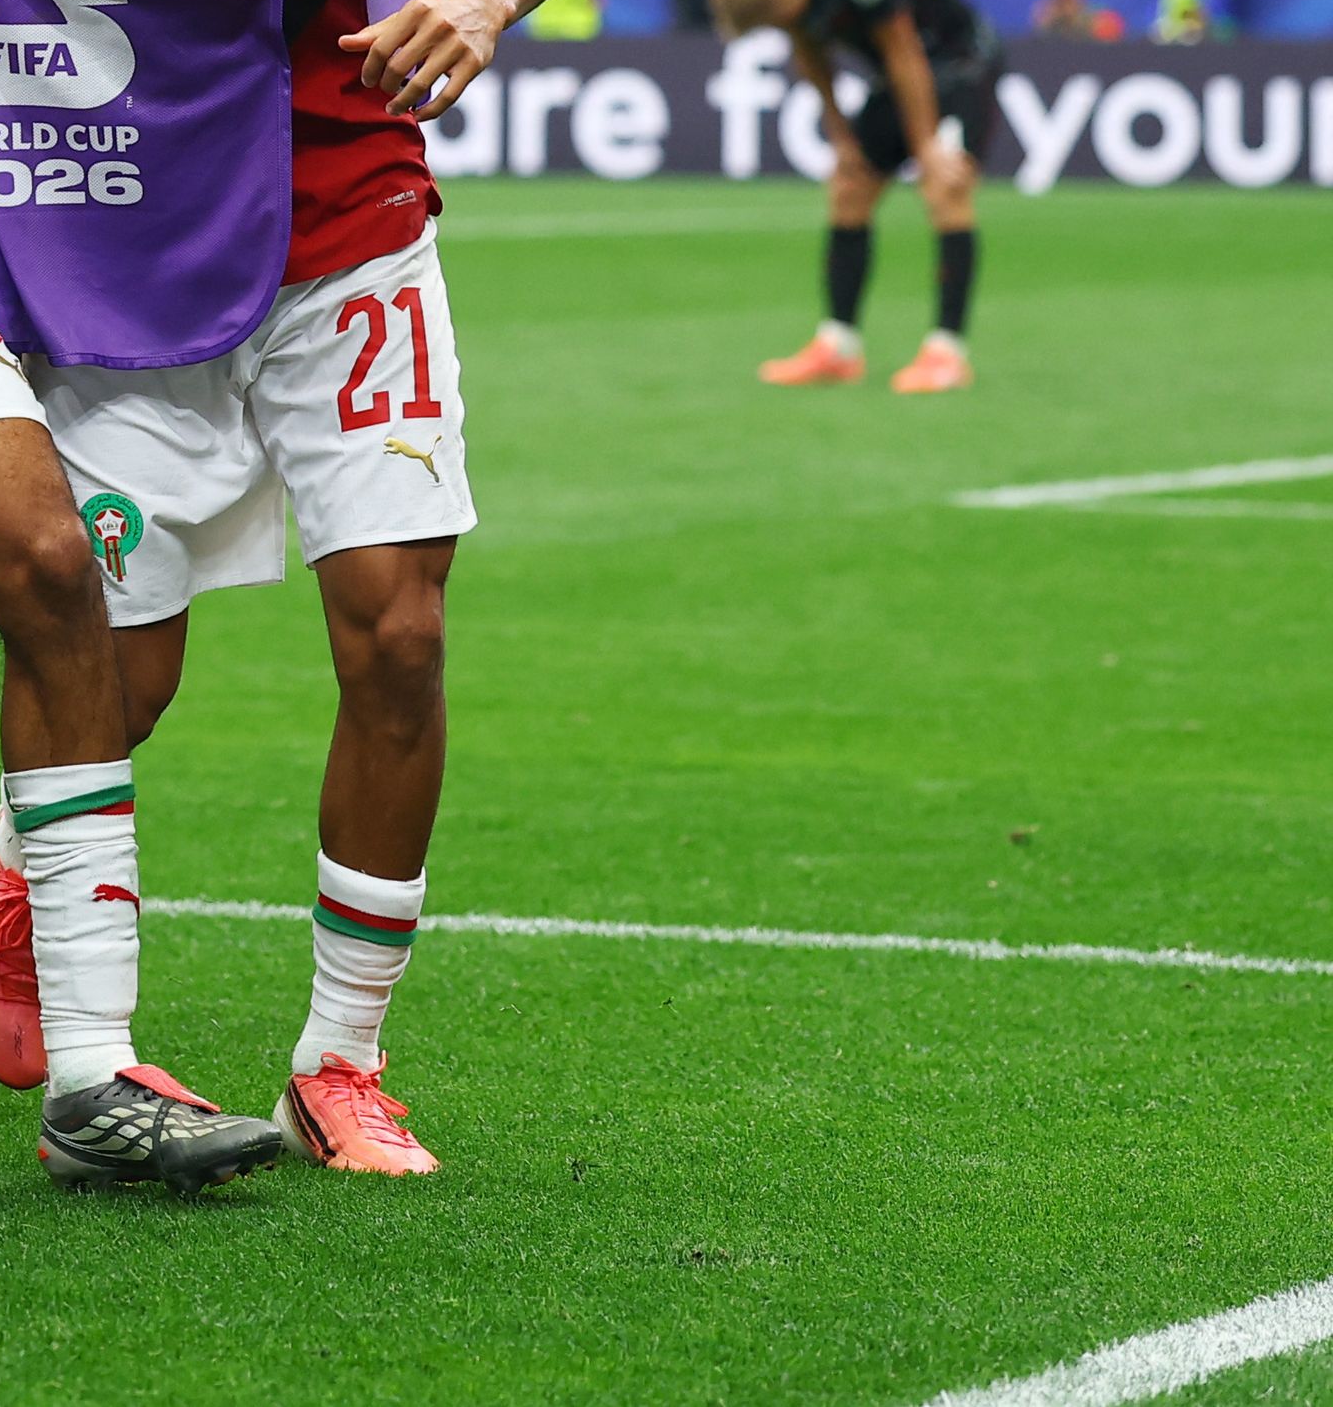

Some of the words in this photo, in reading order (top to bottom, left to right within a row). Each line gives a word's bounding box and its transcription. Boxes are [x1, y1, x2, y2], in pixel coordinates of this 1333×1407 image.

[65, 124, 141, 153] CUP
[994, 72, 1333, 195] you
[335, 287, 442, 433] 21
